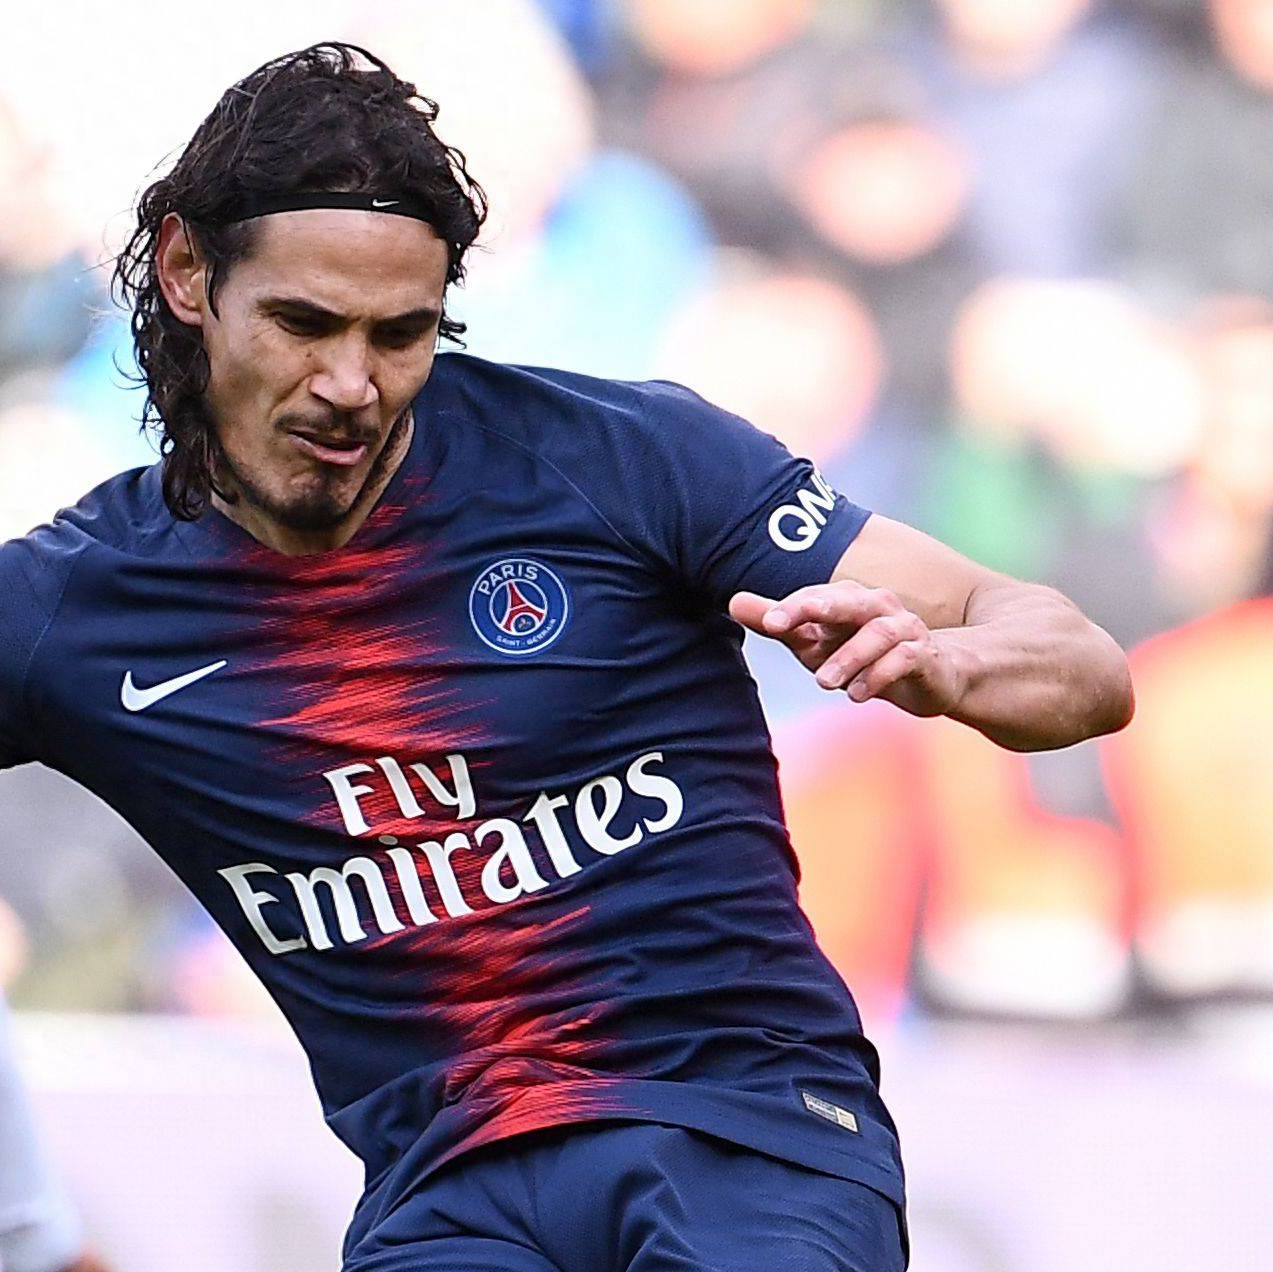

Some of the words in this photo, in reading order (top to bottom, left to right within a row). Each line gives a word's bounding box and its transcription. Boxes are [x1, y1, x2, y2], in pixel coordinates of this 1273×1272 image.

[768, 470, 837, 552] QN
[478, 563, 539, 596] PARIS
[322, 753, 478, 837] Fly
[216, 751, 685, 955] Emirates
